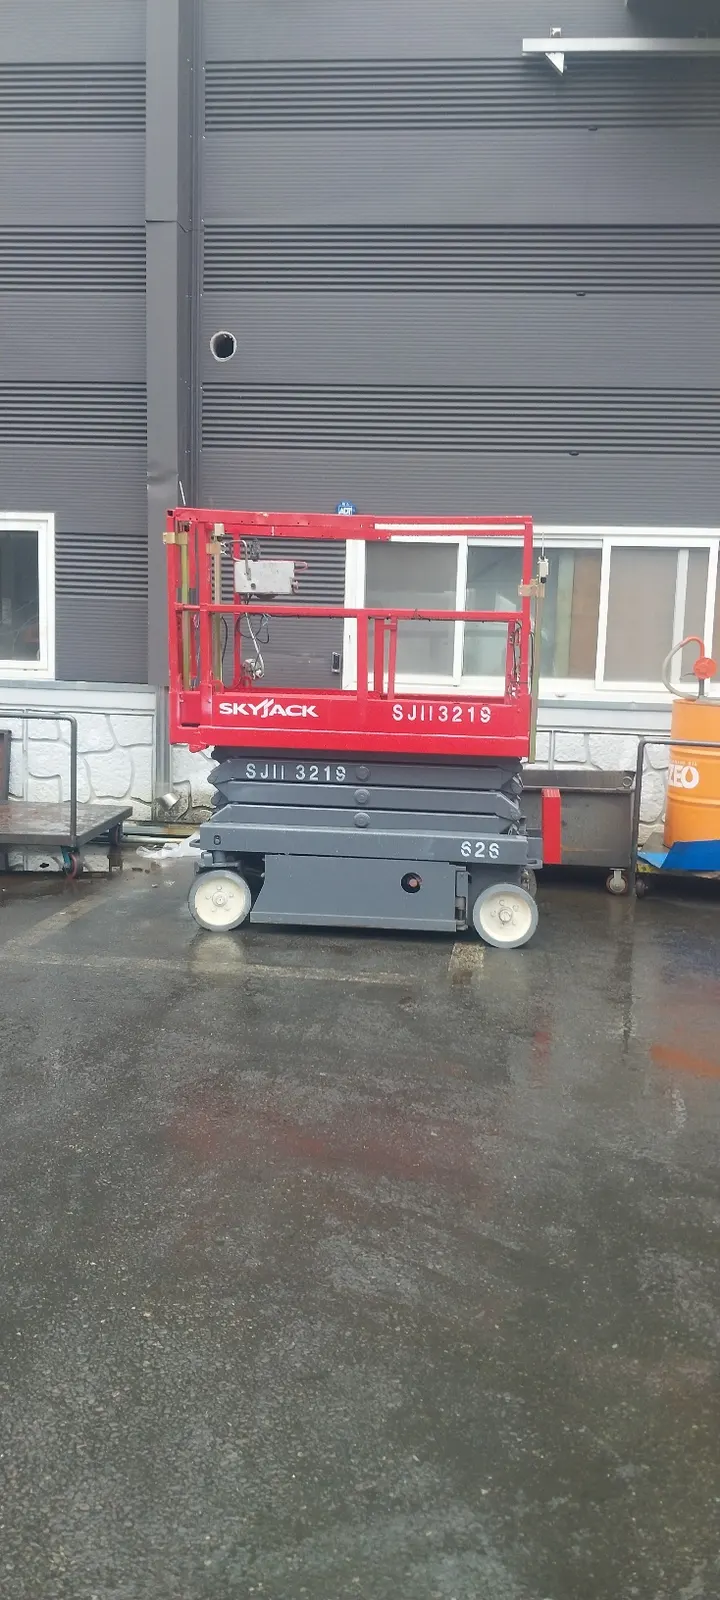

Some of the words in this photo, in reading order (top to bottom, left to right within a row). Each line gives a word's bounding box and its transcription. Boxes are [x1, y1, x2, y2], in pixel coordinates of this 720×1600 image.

[338, 507, 353, 516] ADT
[219, 698, 319, 718] SKYJACK
[295, 764, 346, 782] 3219
